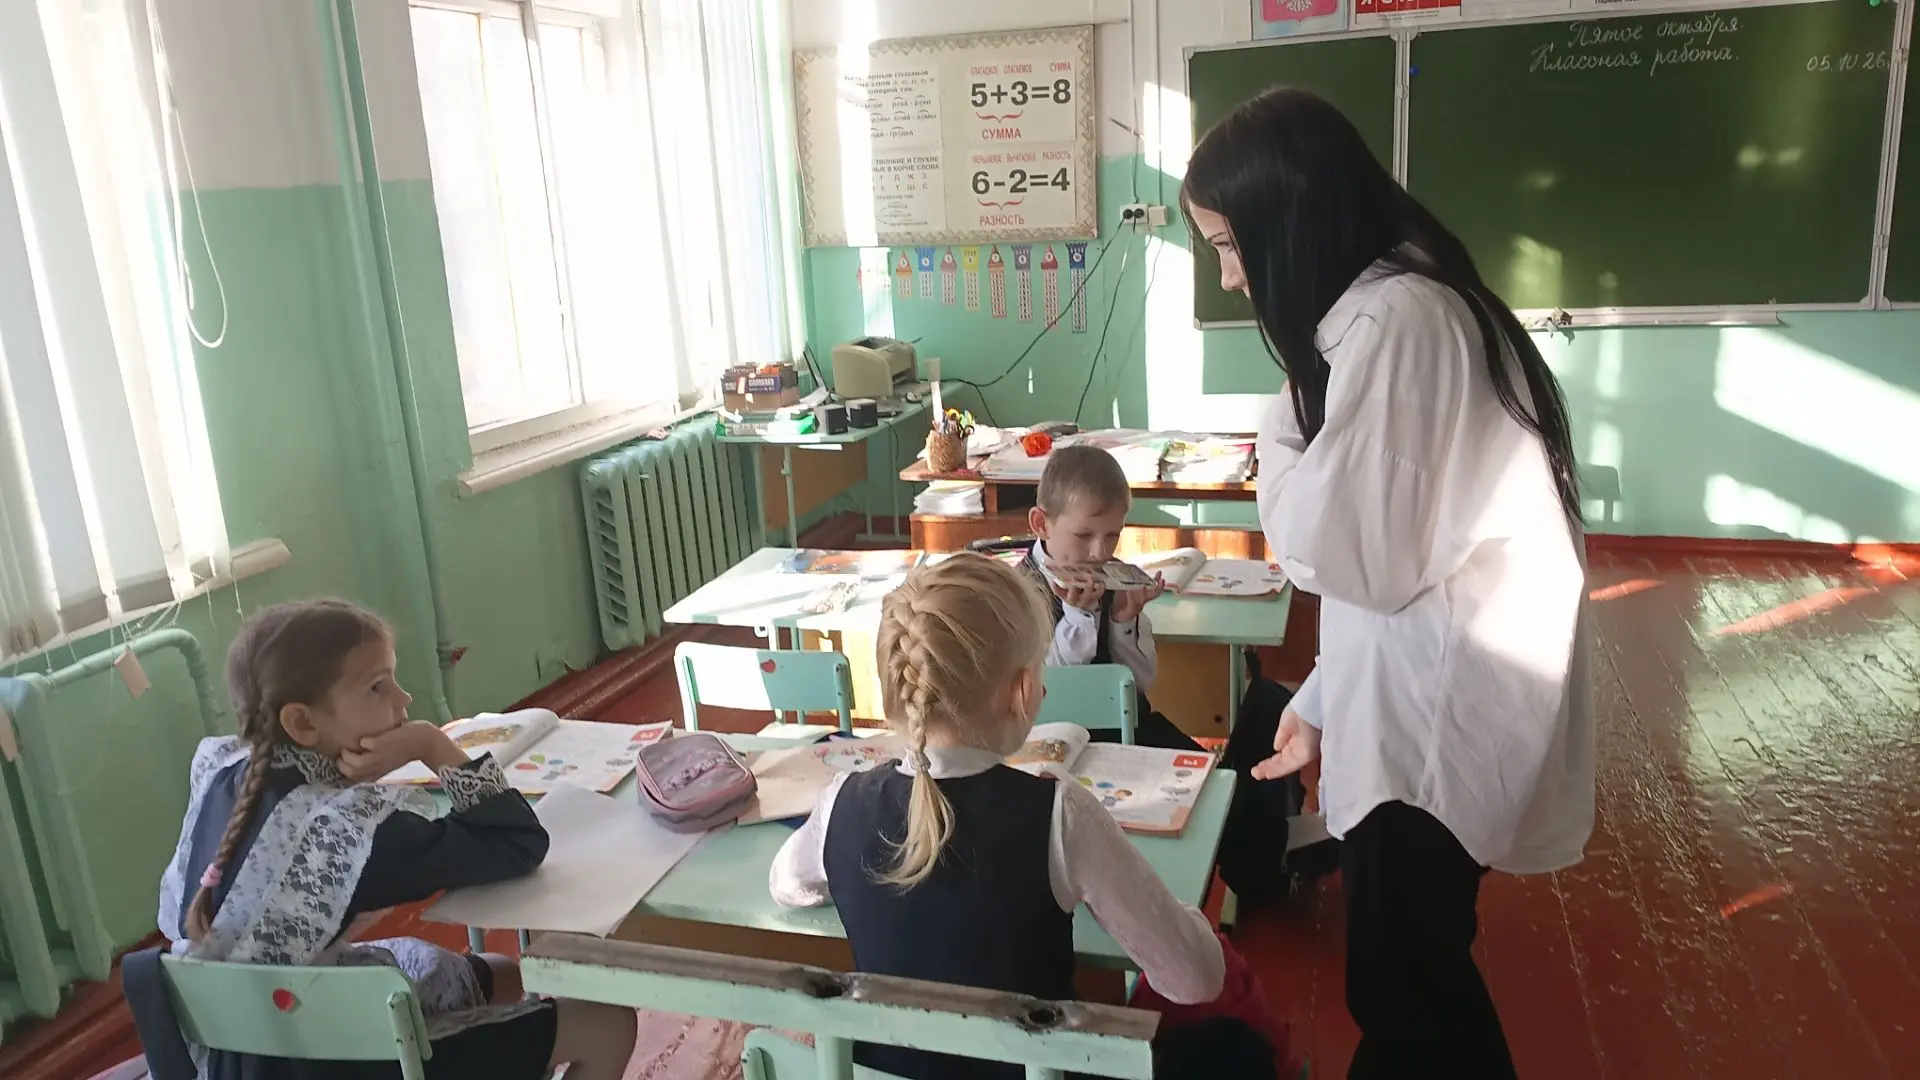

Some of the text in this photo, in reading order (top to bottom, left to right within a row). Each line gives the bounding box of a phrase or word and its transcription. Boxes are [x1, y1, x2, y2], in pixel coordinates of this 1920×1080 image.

[1567, 20, 1643, 48] Пятое
[1049, 61, 1072, 72] СУММА
[1529, 41, 1643, 73] Классная
[971, 78, 1071, 107] 5+3=8
[981, 127, 1022, 140] СУММА
[1042, 150, 1071, 160] РАЗНОСТЬ
[972, 167, 1070, 195] 6-2=4
[980, 214, 1025, 226] РАЗНОСТЬ
